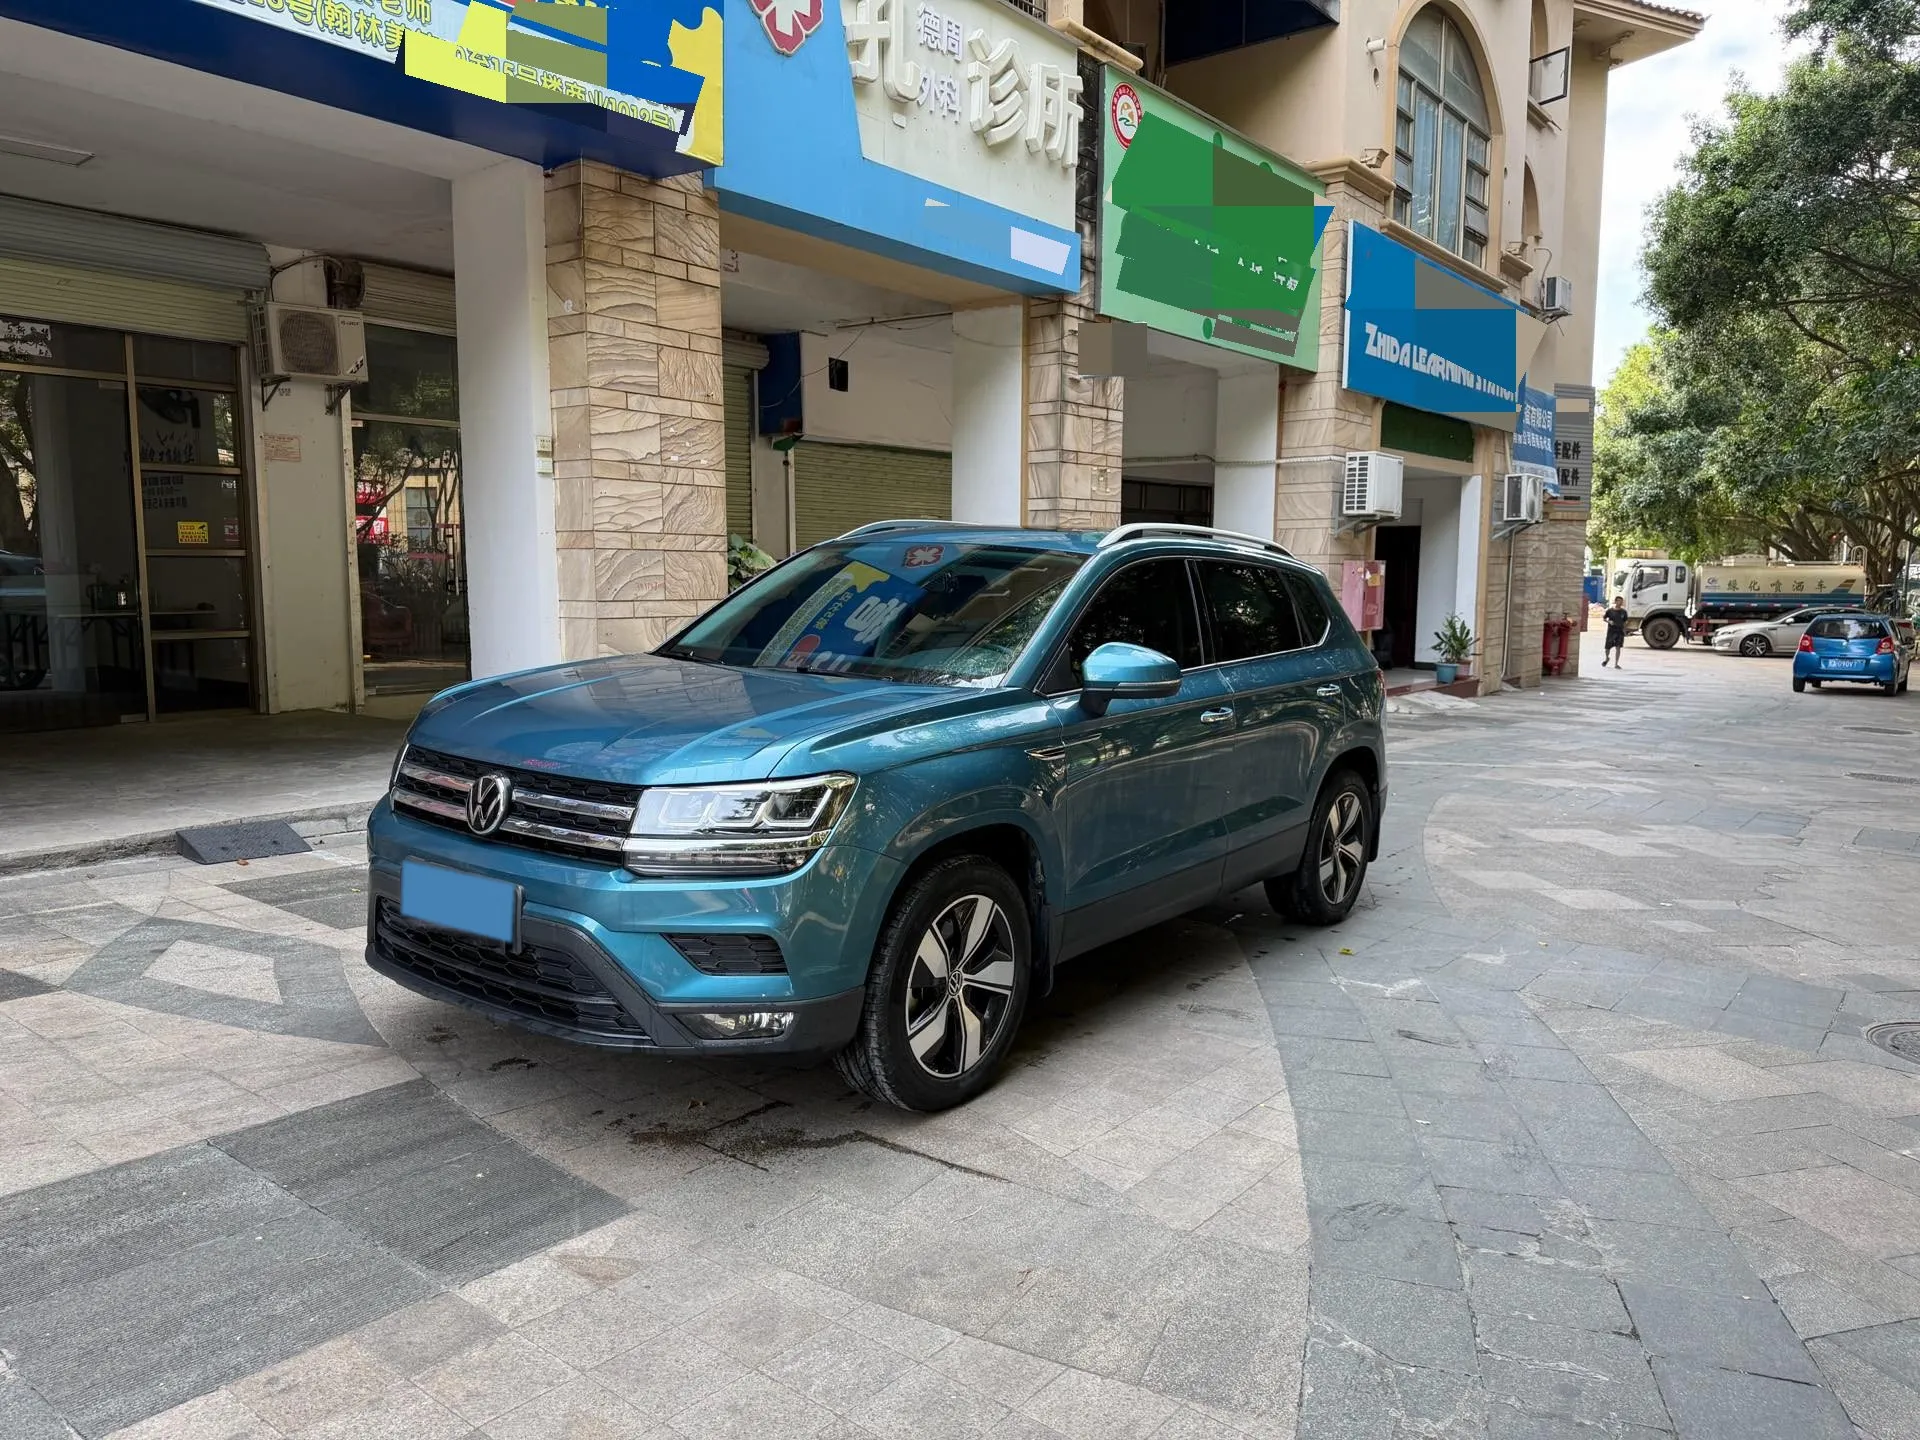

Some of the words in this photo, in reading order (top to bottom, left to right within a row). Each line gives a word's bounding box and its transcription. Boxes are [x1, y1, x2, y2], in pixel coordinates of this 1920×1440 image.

[916, 66, 962, 124] 外科
[967, 28, 1084, 168] 诊所
[1364, 321, 1411, 368] ZHIDA
